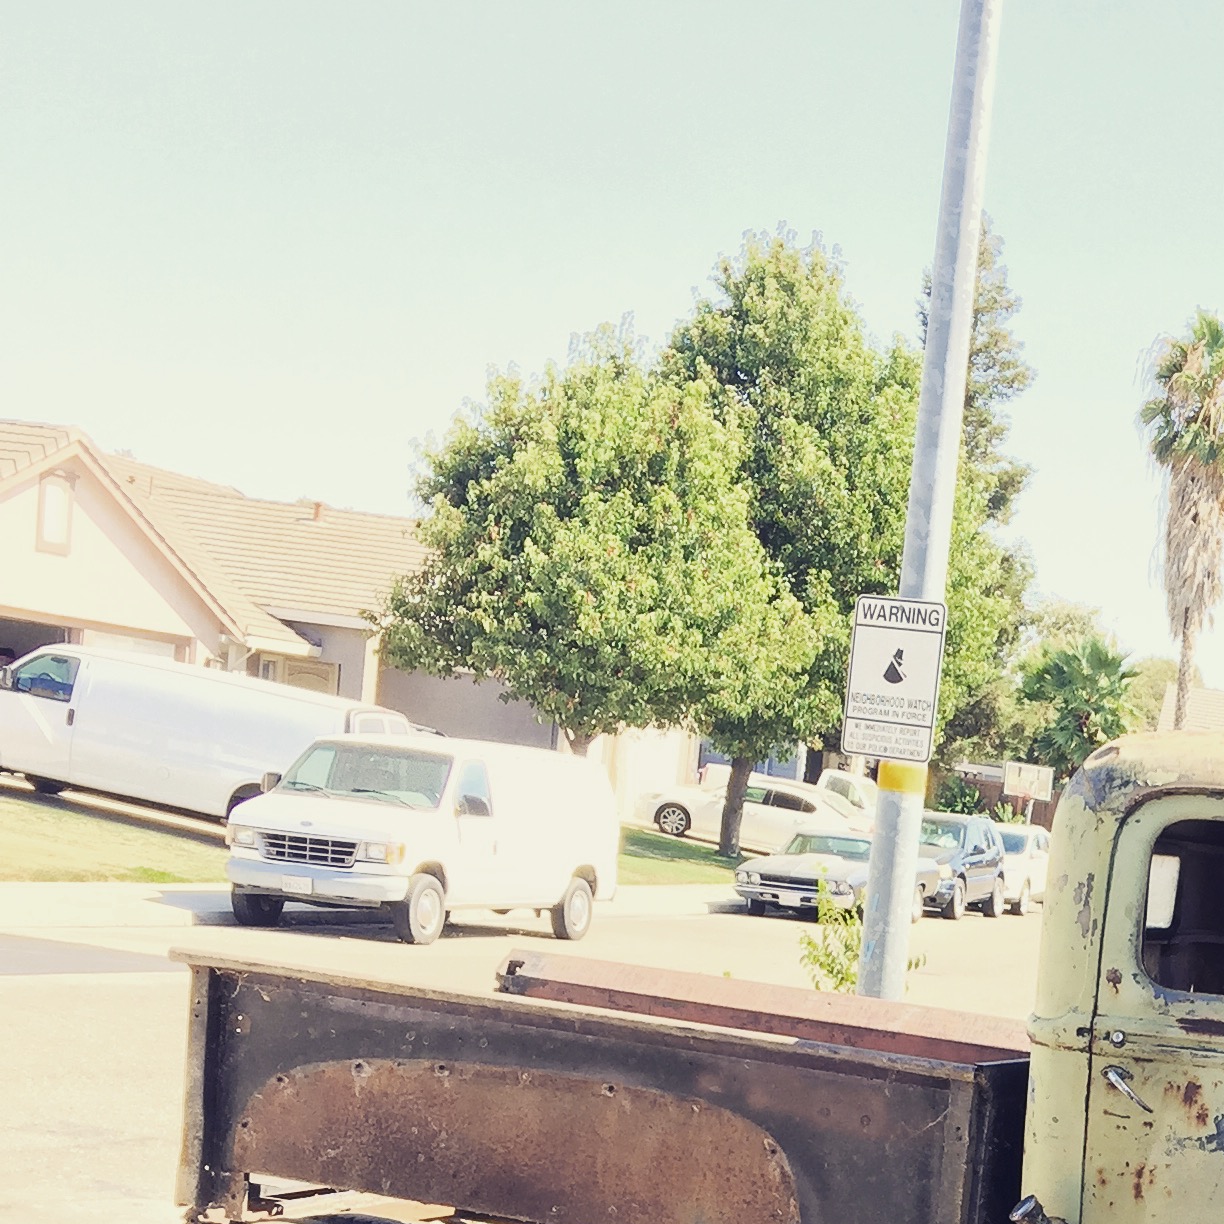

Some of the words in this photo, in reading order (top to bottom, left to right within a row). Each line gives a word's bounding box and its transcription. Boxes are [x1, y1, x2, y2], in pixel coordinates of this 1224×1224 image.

[863, 603, 941, 627] WARNING
[851, 692, 905, 708] NEIGHBORHOOD
[907, 698, 931, 711] WATCH
[852, 705, 890, 716] PROGRAM
[891, 709, 900, 718] IN
[901, 711, 927, 722] FORCE
[868, 743, 889, 753] POLIC
